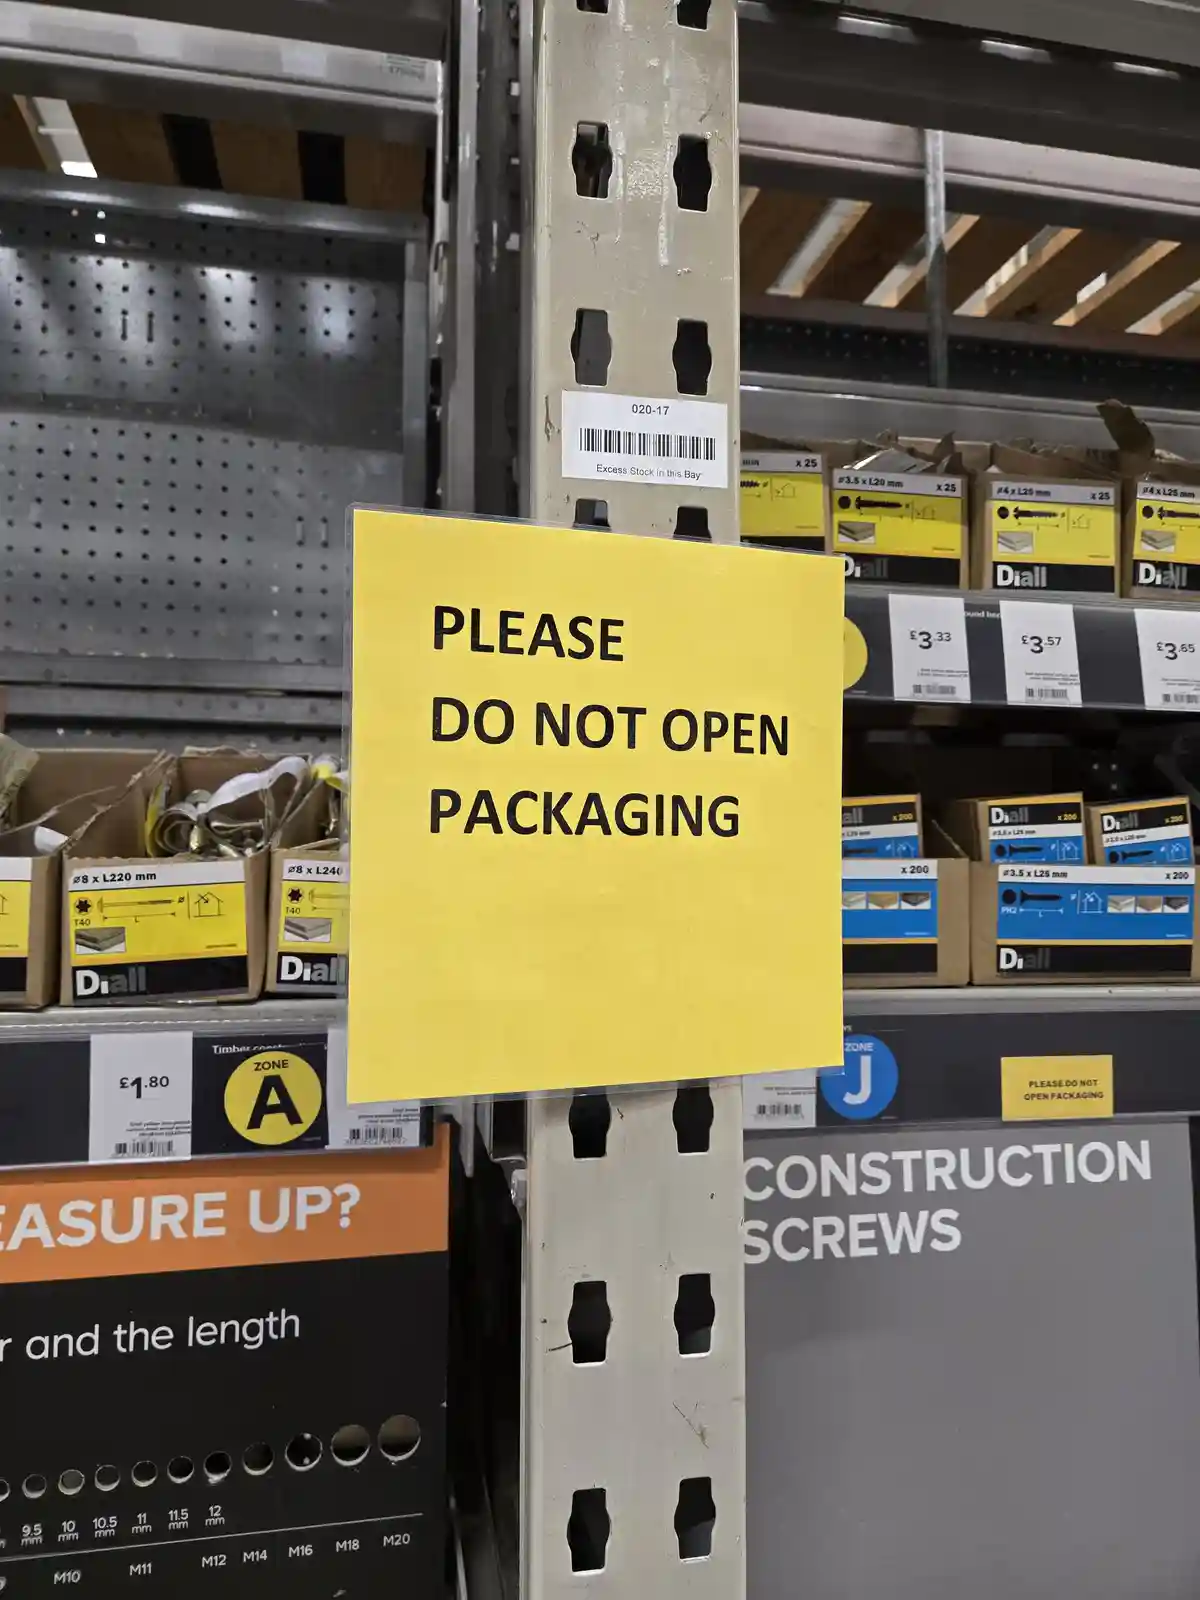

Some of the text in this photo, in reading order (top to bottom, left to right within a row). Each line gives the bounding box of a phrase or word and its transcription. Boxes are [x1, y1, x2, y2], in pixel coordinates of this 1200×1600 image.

[632, 404, 670, 415] 020-17
[804, 458, 818, 468] 25
[596, 464, 701, 481] Excess Stock in this Bay
[886, 480, 904, 488] mm
[944, 483, 957, 492] 25
[1098, 492, 1110, 500] 25
[996, 564, 1048, 588] Diall
[1138, 562, 1188, 587] Diall
[434, 605, 624, 662] PLEASE
[910, 630, 952, 650] £3.33
[1021, 635, 1062, 654] £3.57
[1156, 642, 1196, 660] £3.65
[432, 696, 789, 756] DO NOT OPEN
[430, 788, 739, 837] PACKAGING
[842, 807, 863, 824] all
[991, 807, 1029, 824] Diall
[1102, 813, 1139, 832] Diall
[901, 865, 929, 874] x 200
[1172, 872, 1189, 880] 200
[103, 873, 132, 882] L220
[135, 872, 157, 881] mm
[285, 906, 301, 914] T40
[73, 918, 91, 927] T40
[1000, 948, 1050, 970] Diall
[280, 955, 347, 981] Diall
[76, 966, 147, 996] Diall
[844, 1042, 874, 1052] ZONE
[253, 1059, 289, 1072] ZONE
[119, 1075, 170, 1099] £1.80
[843, 1055, 871, 1105] J
[1029, 1079, 1098, 1088] PLEASE DO NOT
[246, 1075, 304, 1130] A
[1024, 1091, 1104, 1101] OPEN PACKAGING
[743, 1139, 1152, 1201] CONSTRUCTION
[0, 1183, 361, 1251] ASURE UP?
[743, 1208, 962, 1264] SCREWS
[0, 1308, 300, 1362] r and the length
[137, 1512, 147, 1524] 11
[168, 1508, 189, 1521] 11.5
[209, 1505, 221, 1517] 12
[61, 1520, 76, 1533] 10
[92, 1516, 118, 1529] 10.5
[168, 1520, 189, 1530] mm
[205, 1516, 225, 1526] mm
[22, 1523, 42, 1537] 9.5
[94, 1528, 115, 1538] mm
[131, 1524, 152, 1534] mm
[21, 1536, 42, 1546] mm
[58, 1532, 79, 1542] mm
[383, 1533, 411, 1547] M20
[288, 1544, 313, 1558] M16
[335, 1539, 360, 1552] M18
[201, 1554, 227, 1568] M12
[243, 1549, 268, 1563] M14
[129, 1562, 152, 1576] M11
[53, 1570, 81, 1585] M10
